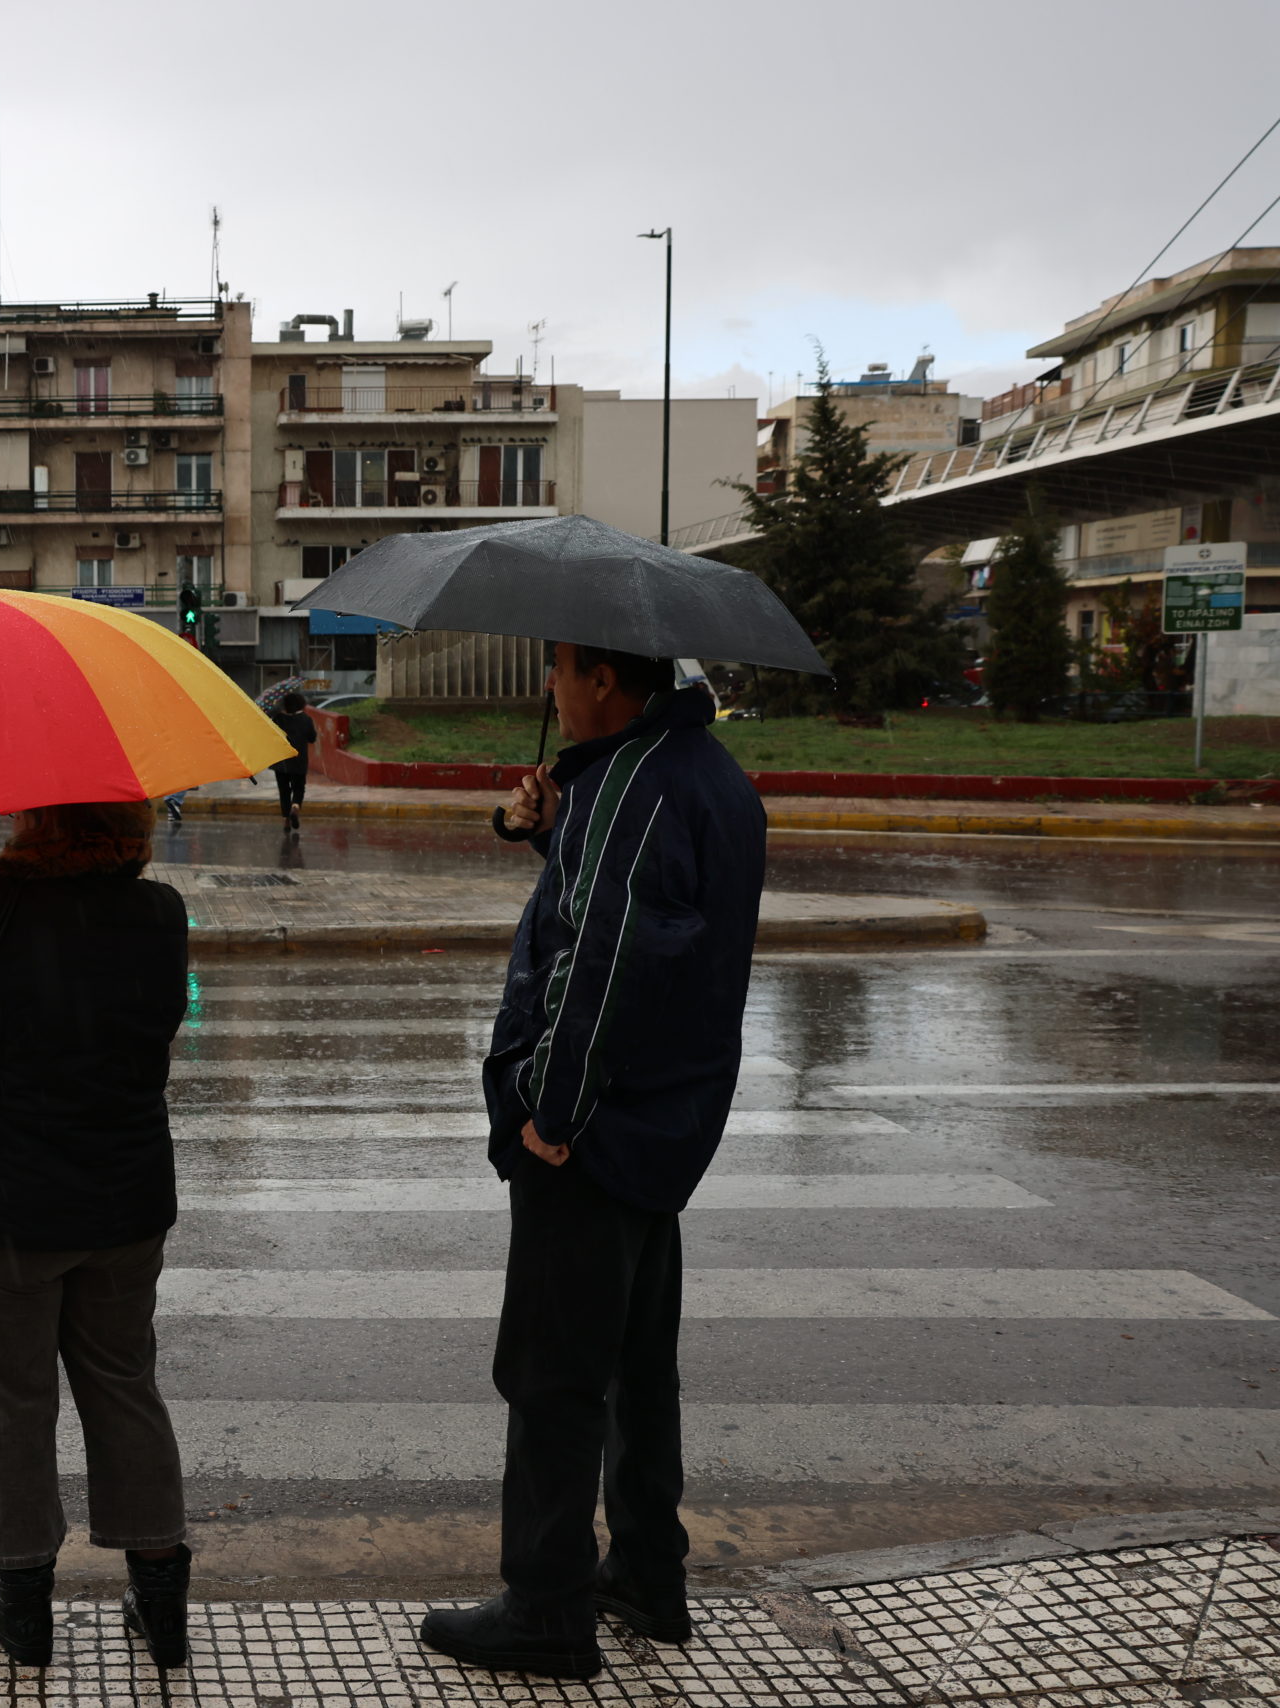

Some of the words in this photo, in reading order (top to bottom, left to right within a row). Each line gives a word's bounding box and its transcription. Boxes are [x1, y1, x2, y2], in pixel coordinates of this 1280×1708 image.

[1171, 609, 1185, 618] ΤΟ
[1187, 608, 1235, 617] ΠΡΑΣΙΝΟ
[1175, 619, 1205, 628] ΕΙΝΑΙ
[1207, 618, 1230, 628] ΖΩΗ
